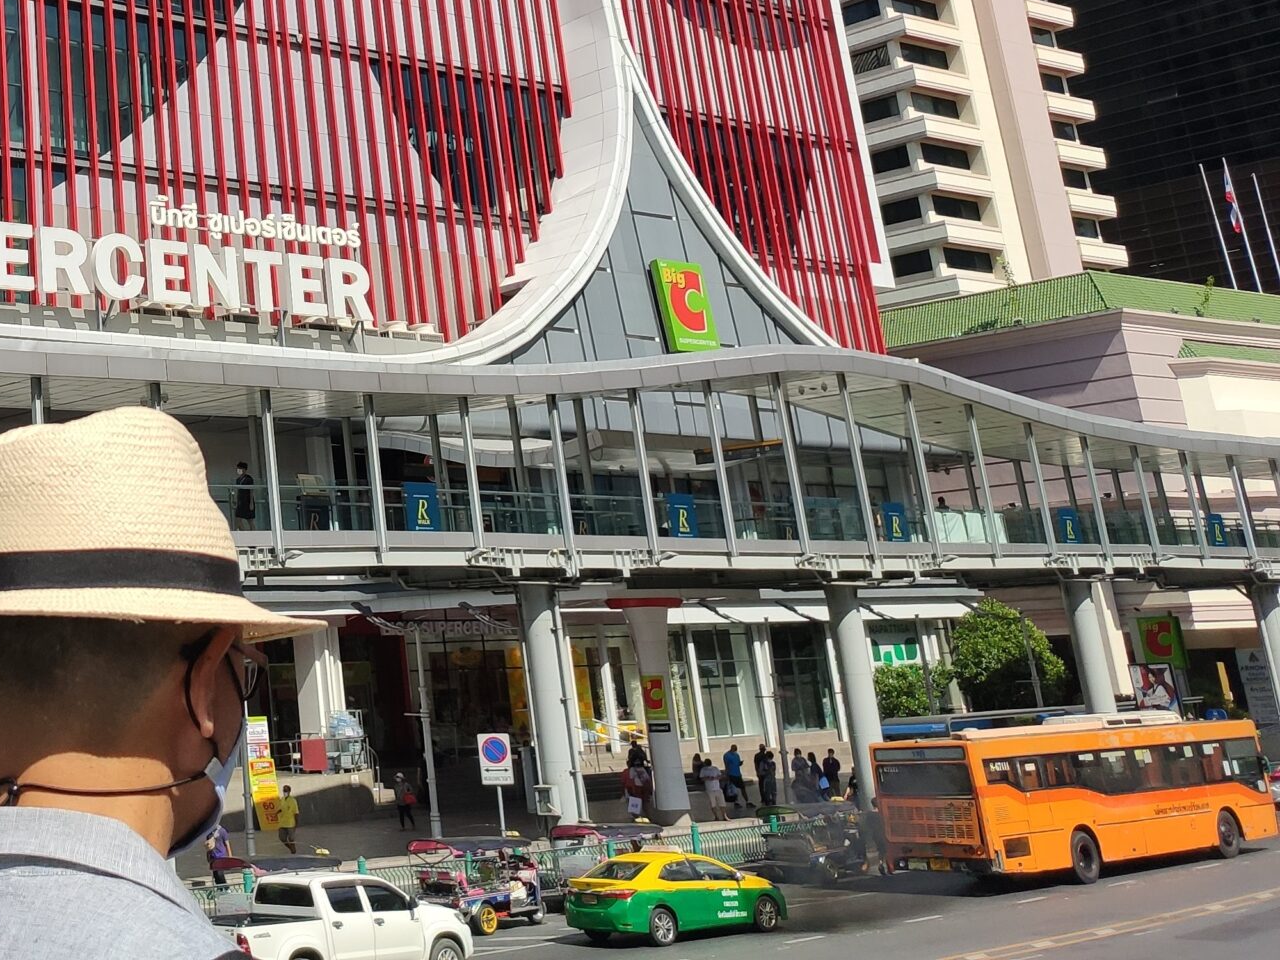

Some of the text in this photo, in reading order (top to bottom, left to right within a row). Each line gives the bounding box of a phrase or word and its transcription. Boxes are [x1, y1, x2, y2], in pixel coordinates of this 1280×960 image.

[662, 267, 687, 289] Big
[669, 269, 708, 334] C
[418, 499, 430, 520] R
[679, 508, 690, 528] R
[892, 516, 902, 533] R
[1146, 620, 1173, 658] C
